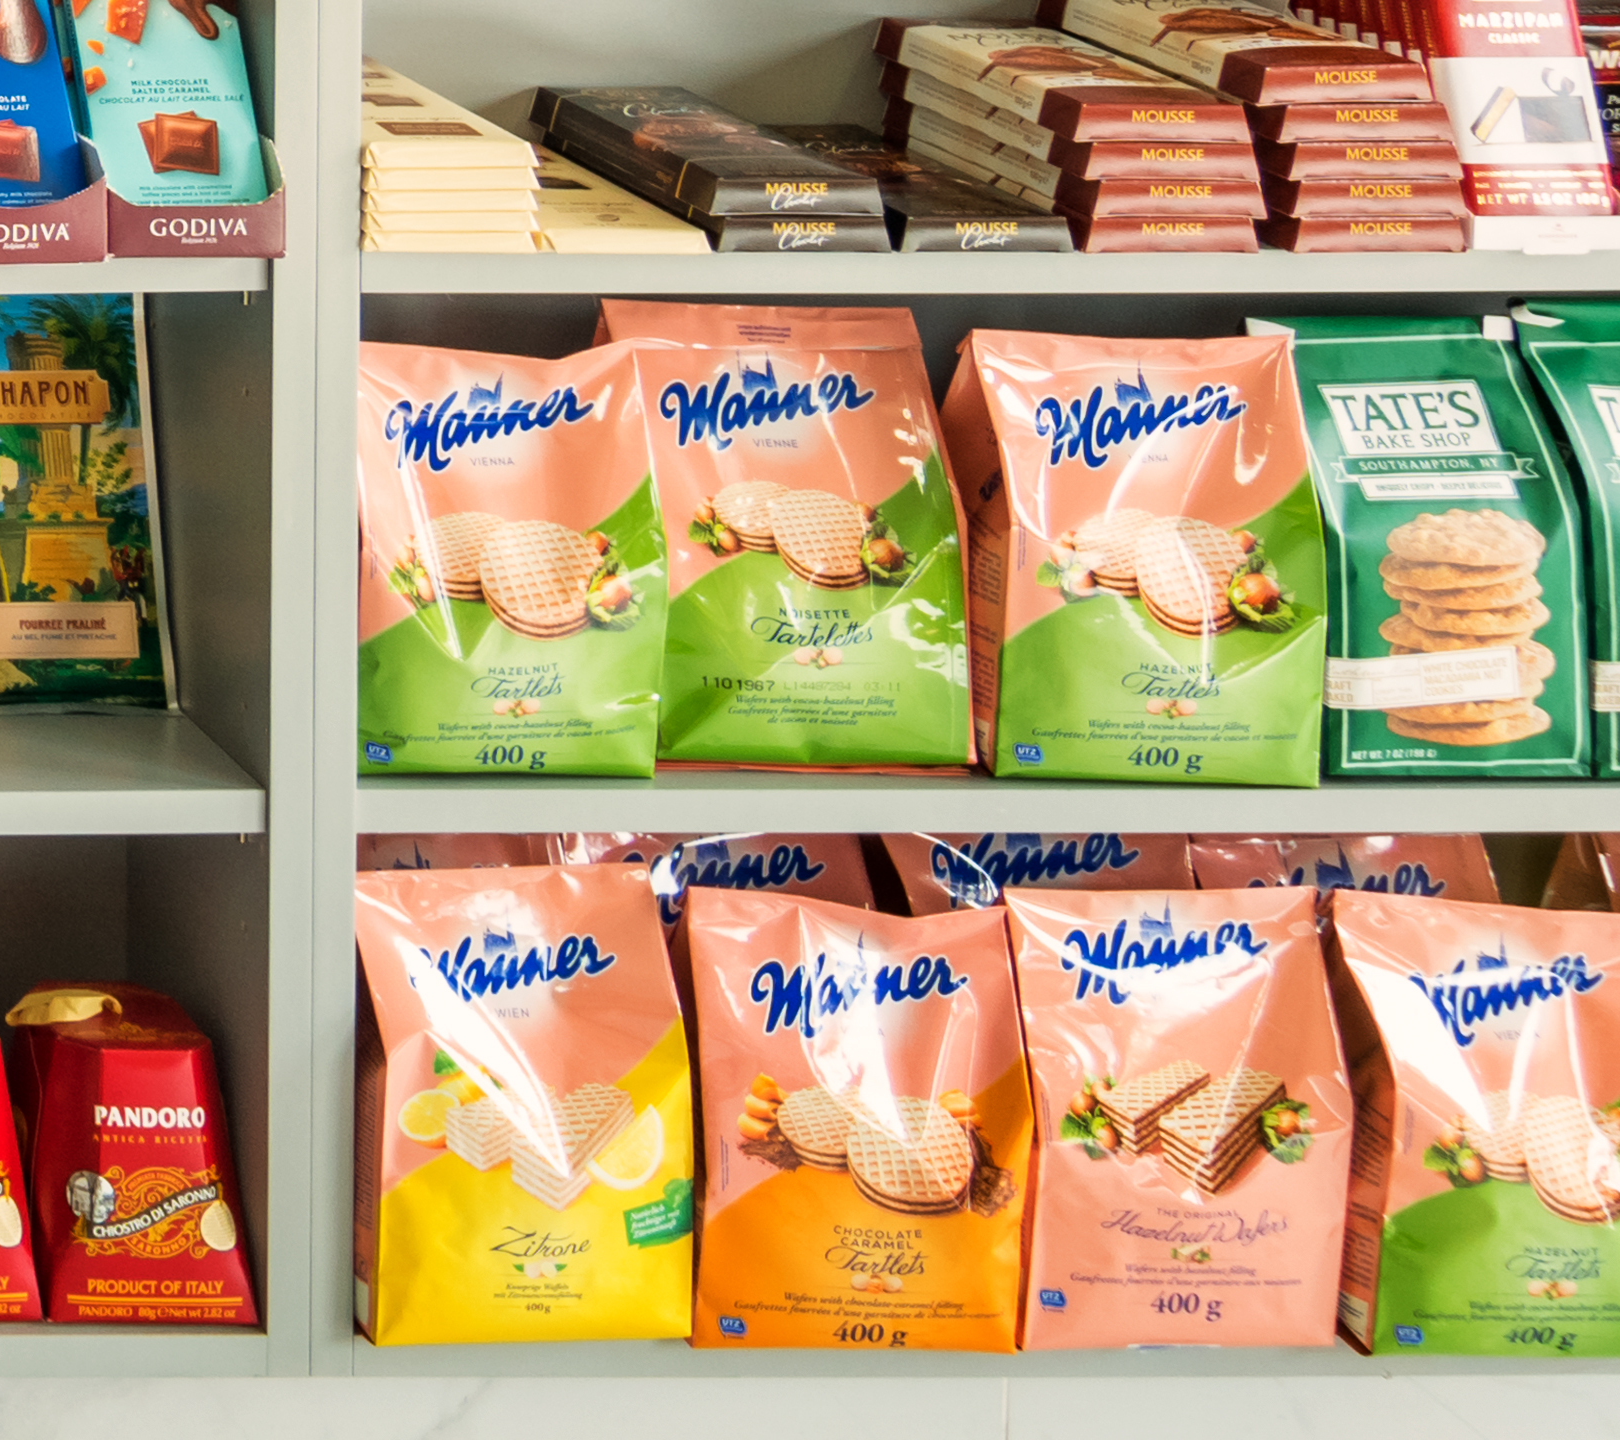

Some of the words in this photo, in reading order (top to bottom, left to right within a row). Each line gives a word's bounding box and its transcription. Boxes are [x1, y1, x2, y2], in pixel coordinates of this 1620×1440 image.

[1489, 32, 1540, 43] CLASSIC
[1314, 71, 1377, 84] MOUSSE
[1132, 109, 1196, 124] MOUSSE
[765, 182, 828, 196] MOUSSE
[149, 217, 246, 238] GODIVA
[955, 222, 1018, 235] MOUSSE
[660, 373, 874, 451] Manner
[1331, 390, 1481, 434] TATE'S
[385, 384, 594, 471] Manner
[1036, 382, 1247, 468] Manner
[753, 439, 799, 449] VIENNE
[1362, 432, 1414, 450] BAKE
[1421, 430, 1472, 447] SHOP
[470, 457, 515, 466] VIENNA
[1478, 459, 1500, 469] NY
[471, 676, 563, 700] Tartlets
[475, 746, 524, 765] 400
[530, 749, 546, 768] g
[495, 1008, 530, 1018] WIEN
[94, 1105, 205, 1129] PANDORO
[490, 1226, 591, 1258] Zitrone
